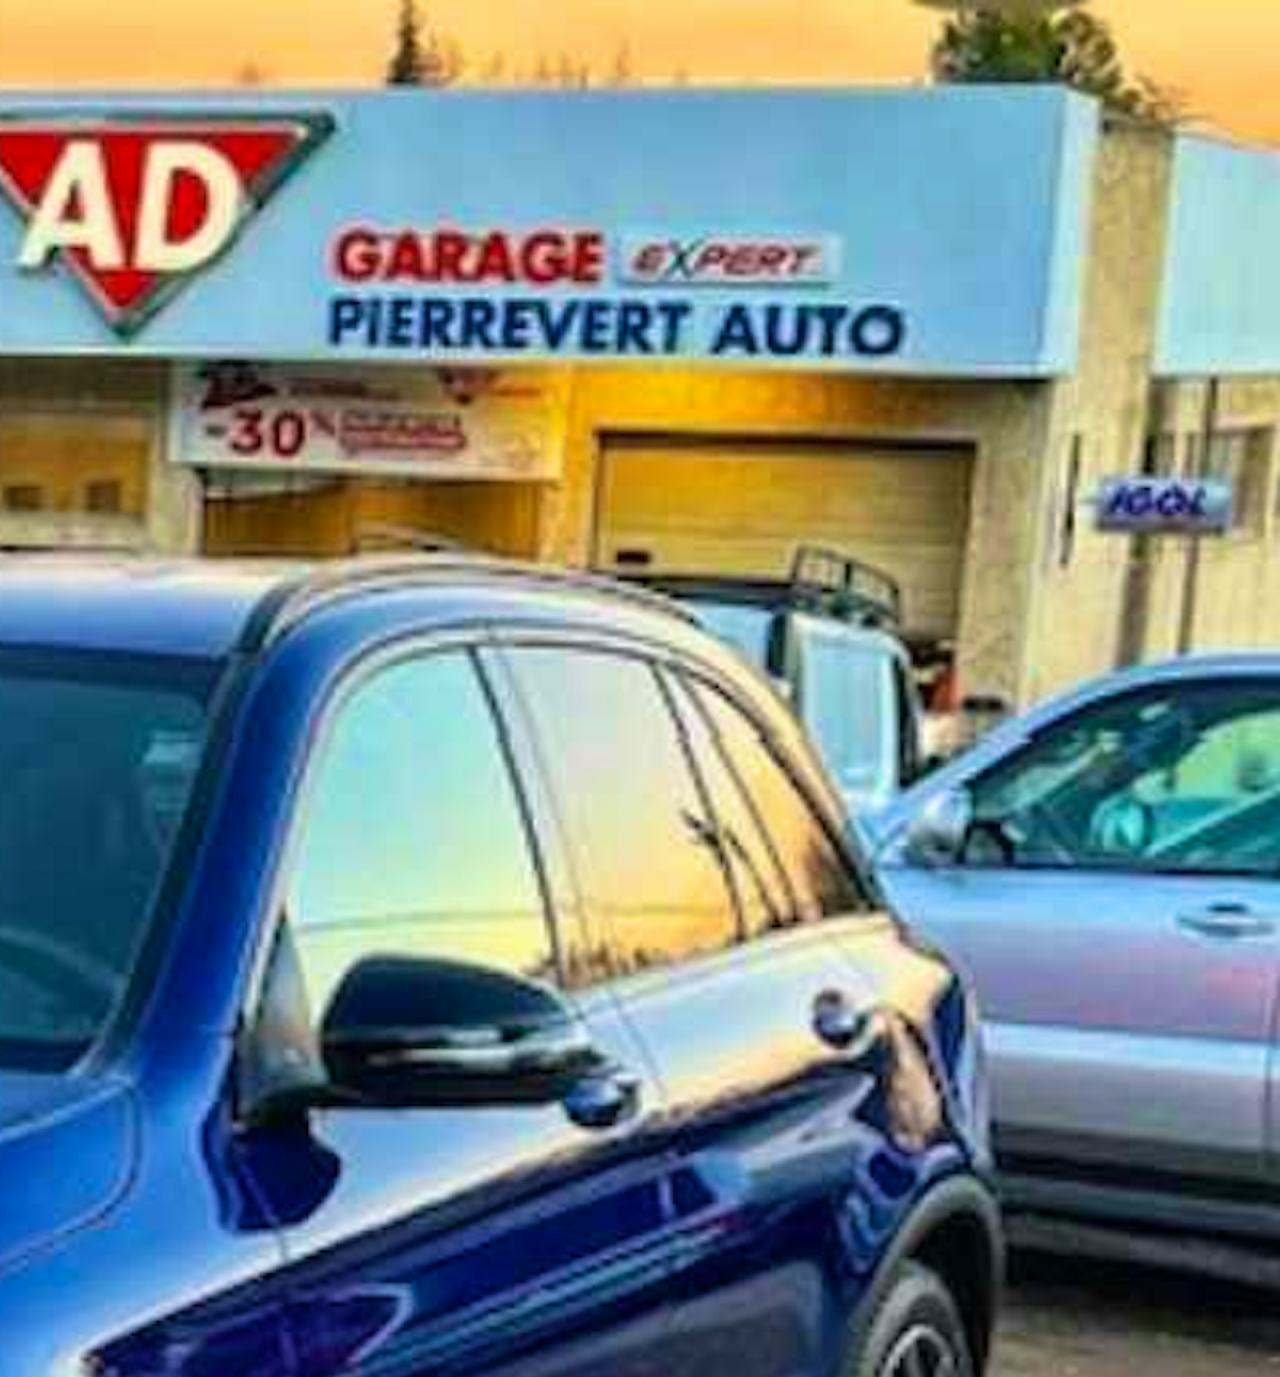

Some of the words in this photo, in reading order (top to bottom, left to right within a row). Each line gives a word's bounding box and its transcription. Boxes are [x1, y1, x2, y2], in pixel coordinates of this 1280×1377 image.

[15, 139, 241, 272] AD
[329, 231, 604, 283] GARAGE
[329, 299, 691, 352] PIERREVERT
[712, 304, 905, 356] AUTO
